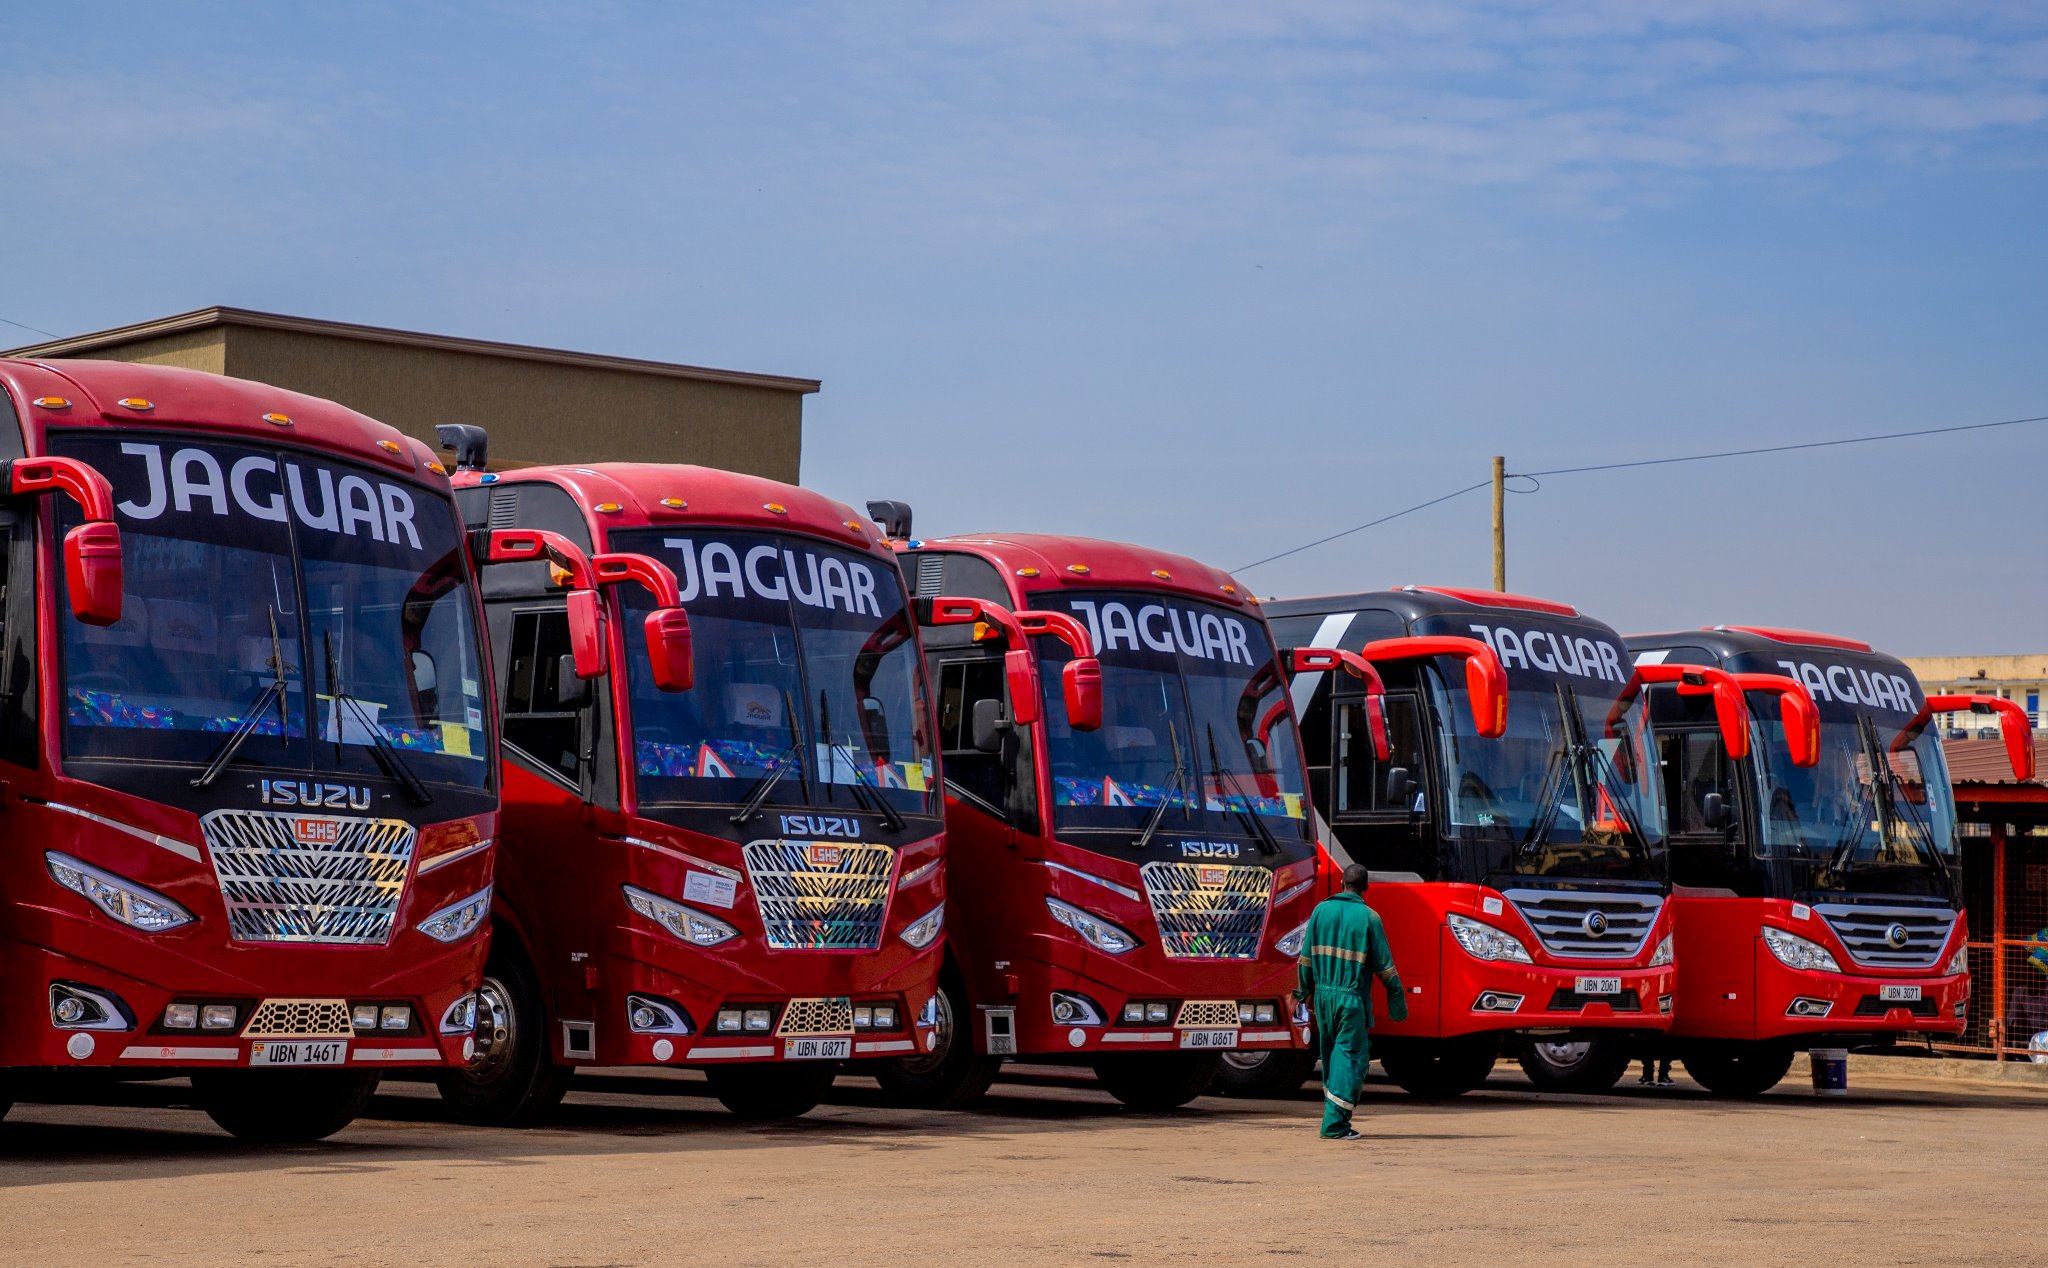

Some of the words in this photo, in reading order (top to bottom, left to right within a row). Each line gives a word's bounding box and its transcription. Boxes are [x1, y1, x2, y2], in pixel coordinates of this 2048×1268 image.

[117, 442, 423, 550] JAGUAR
[664, 538, 883, 618] JAGUAR
[1071, 601, 1254, 666] JAGUAR
[261, 779, 371, 811] ISUZU
[297, 822, 336, 840] LSHS
[780, 815, 860, 838] ISUZU
[811, 848, 839, 863] LSHS
[1181, 841, 1240, 859] ISUZU
[1201, 870, 1224, 884] LSHS
[1584, 979, 1598, 991] UBN
[1601, 979, 1618, 991] 206T
[1888, 987, 1900, 998] UBN
[1191, 1033, 1209, 1046] UBN
[1212, 1032, 1233, 1046] 086T
[269, 1045, 297, 1062] UBN
[303, 1045, 340, 1062] 146T
[797, 1041, 817, 1056] UBN
[821, 1041, 846, 1056] 087T
